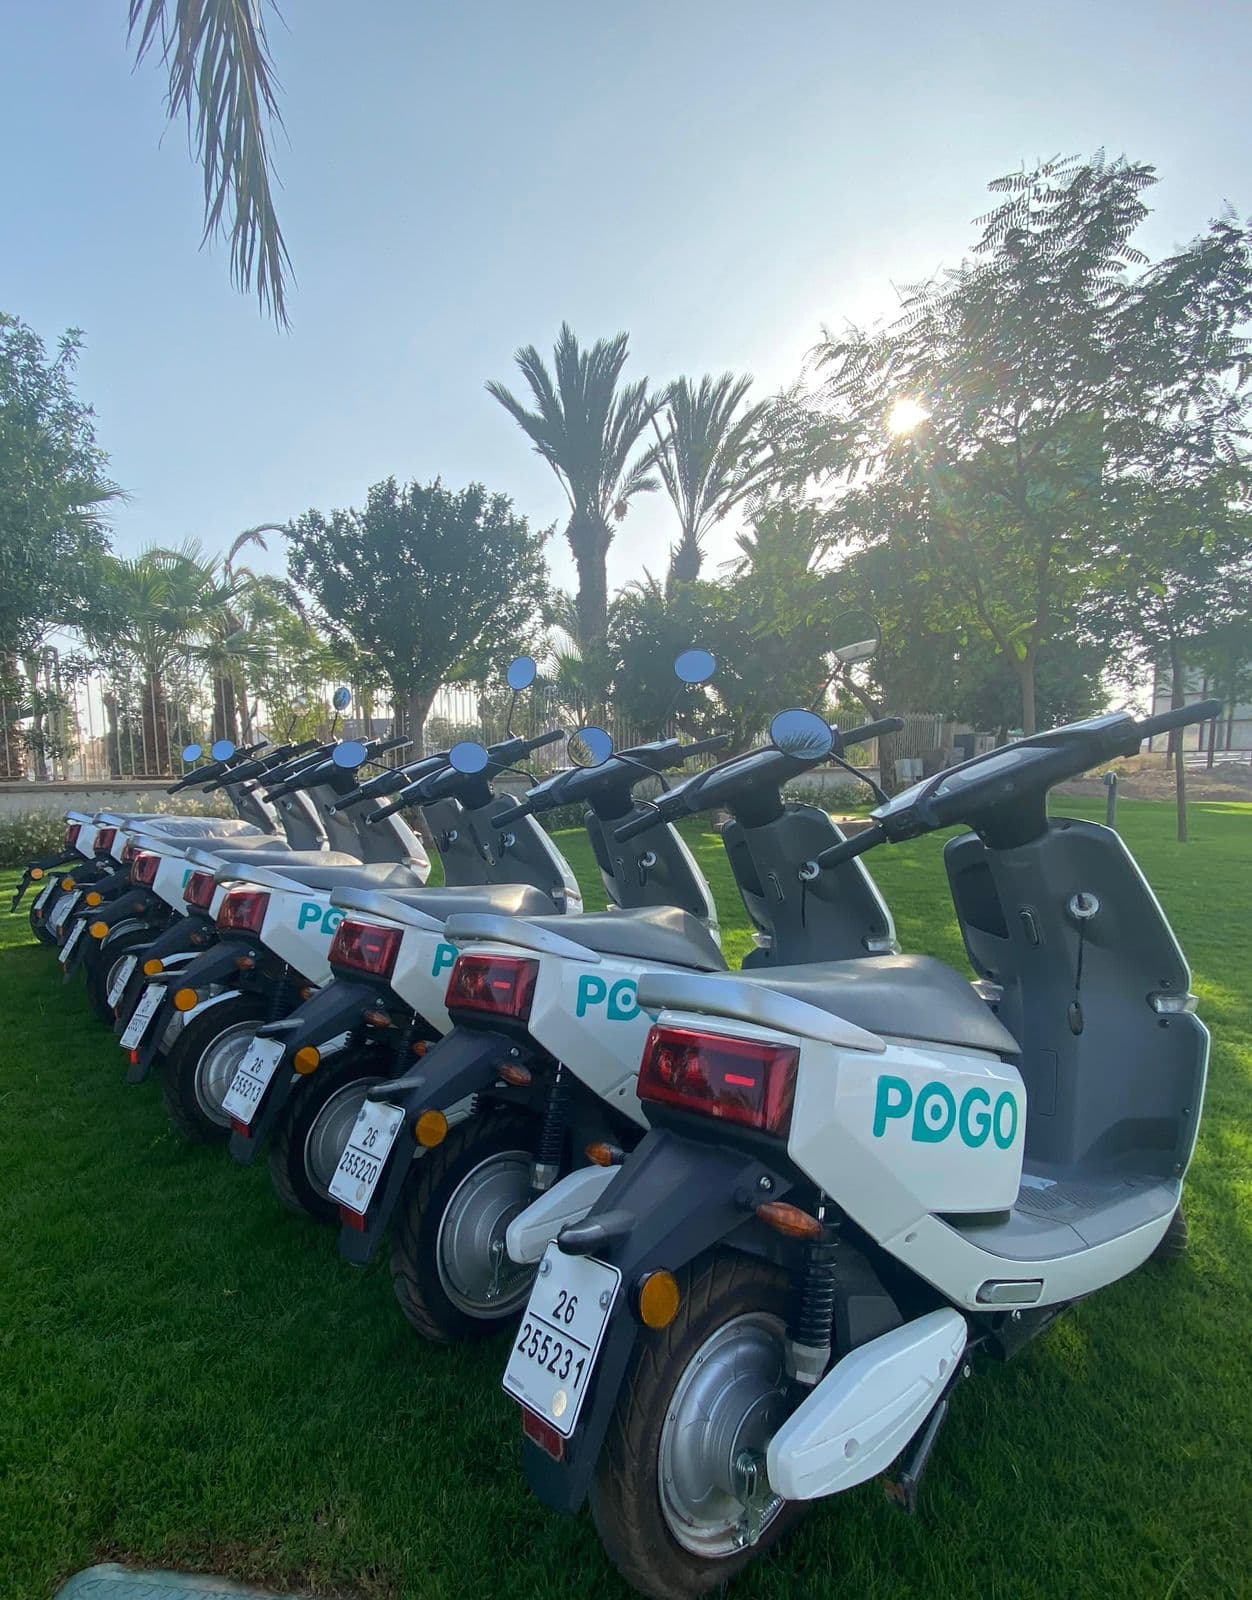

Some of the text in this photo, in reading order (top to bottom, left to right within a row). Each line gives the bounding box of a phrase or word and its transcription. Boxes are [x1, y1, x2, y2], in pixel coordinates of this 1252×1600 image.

[298, 902, 348, 934] PO
[576, 974, 657, 1022] PO
[250, 1057, 264, 1074] 26
[231, 1075, 261, 1102] 255213
[872, 1074, 1018, 1150] POGO
[362, 1127, 379, 1147] 26
[339, 1151, 378, 1184] 255220
[552, 1289, 578, 1325] 26
[517, 1323, 586, 1389] 255231
